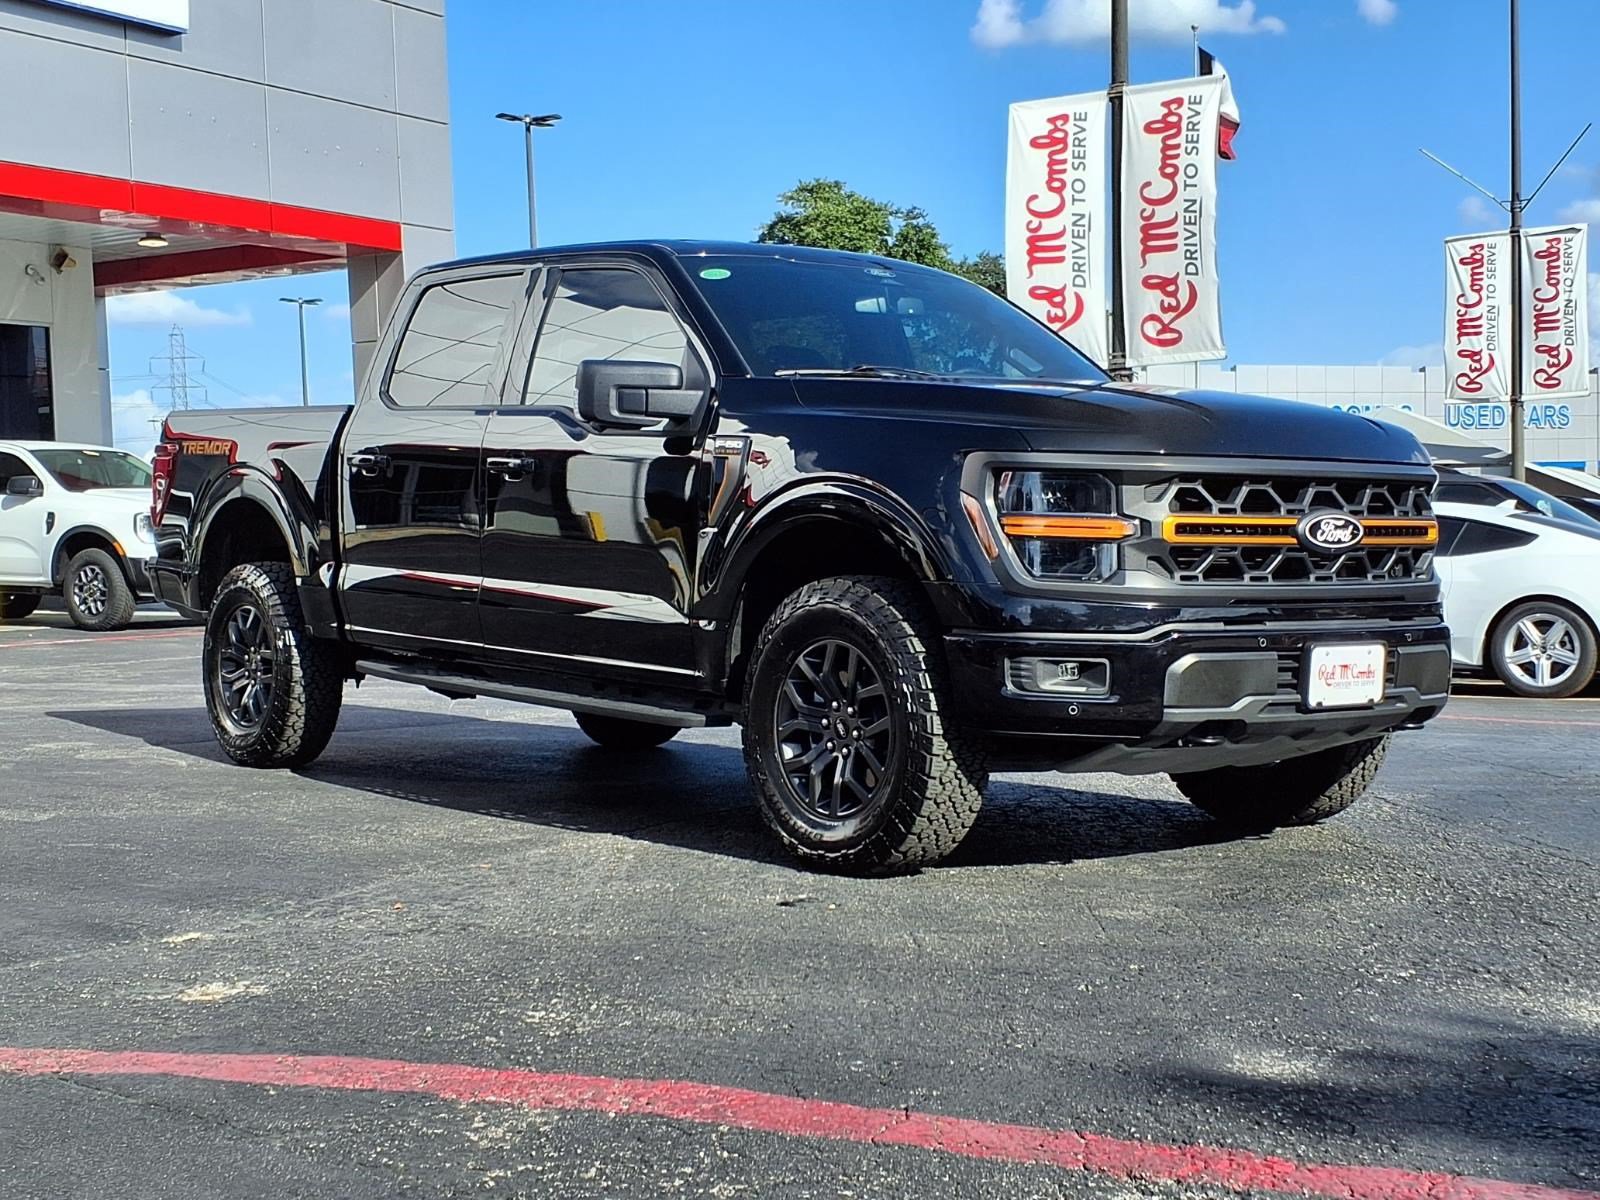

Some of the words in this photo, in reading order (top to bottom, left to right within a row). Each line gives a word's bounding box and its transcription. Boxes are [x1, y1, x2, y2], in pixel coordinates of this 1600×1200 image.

[1072, 111, 1088, 171] SERVE
[1184, 94, 1203, 161] SERVE
[1025, 113, 1069, 279] McCombs
[1072, 177, 1086, 206] TO
[1139, 97, 1185, 269] McCombs
[1184, 163, 1199, 192] TO
[1072, 213, 1087, 289] DRIVEN
[1184, 199, 1199, 277] DRIVEN
[1486, 242, 1497, 280] SERVE
[1563, 236, 1575, 274] SERVE
[1456, 243, 1485, 344] McCombs
[1486, 283, 1497, 300] TO
[1533, 237, 1562, 341] McCombs
[1563, 278, 1574, 295] TO
[1139, 272, 1198, 348] Red
[1486, 305, 1497, 351] DRIVEN
[1563, 299, 1575, 346] DRIVEN
[1455, 349, 1495, 394] Red
[1533, 343, 1573, 390] Red
[1446, 404, 1505, 428] USED
[1522, 405, 1570, 427] ARS
[181, 440, 232, 455] TREMOR
[1316, 519, 1354, 542] Ford
[1318, 664, 1337, 687] Red
